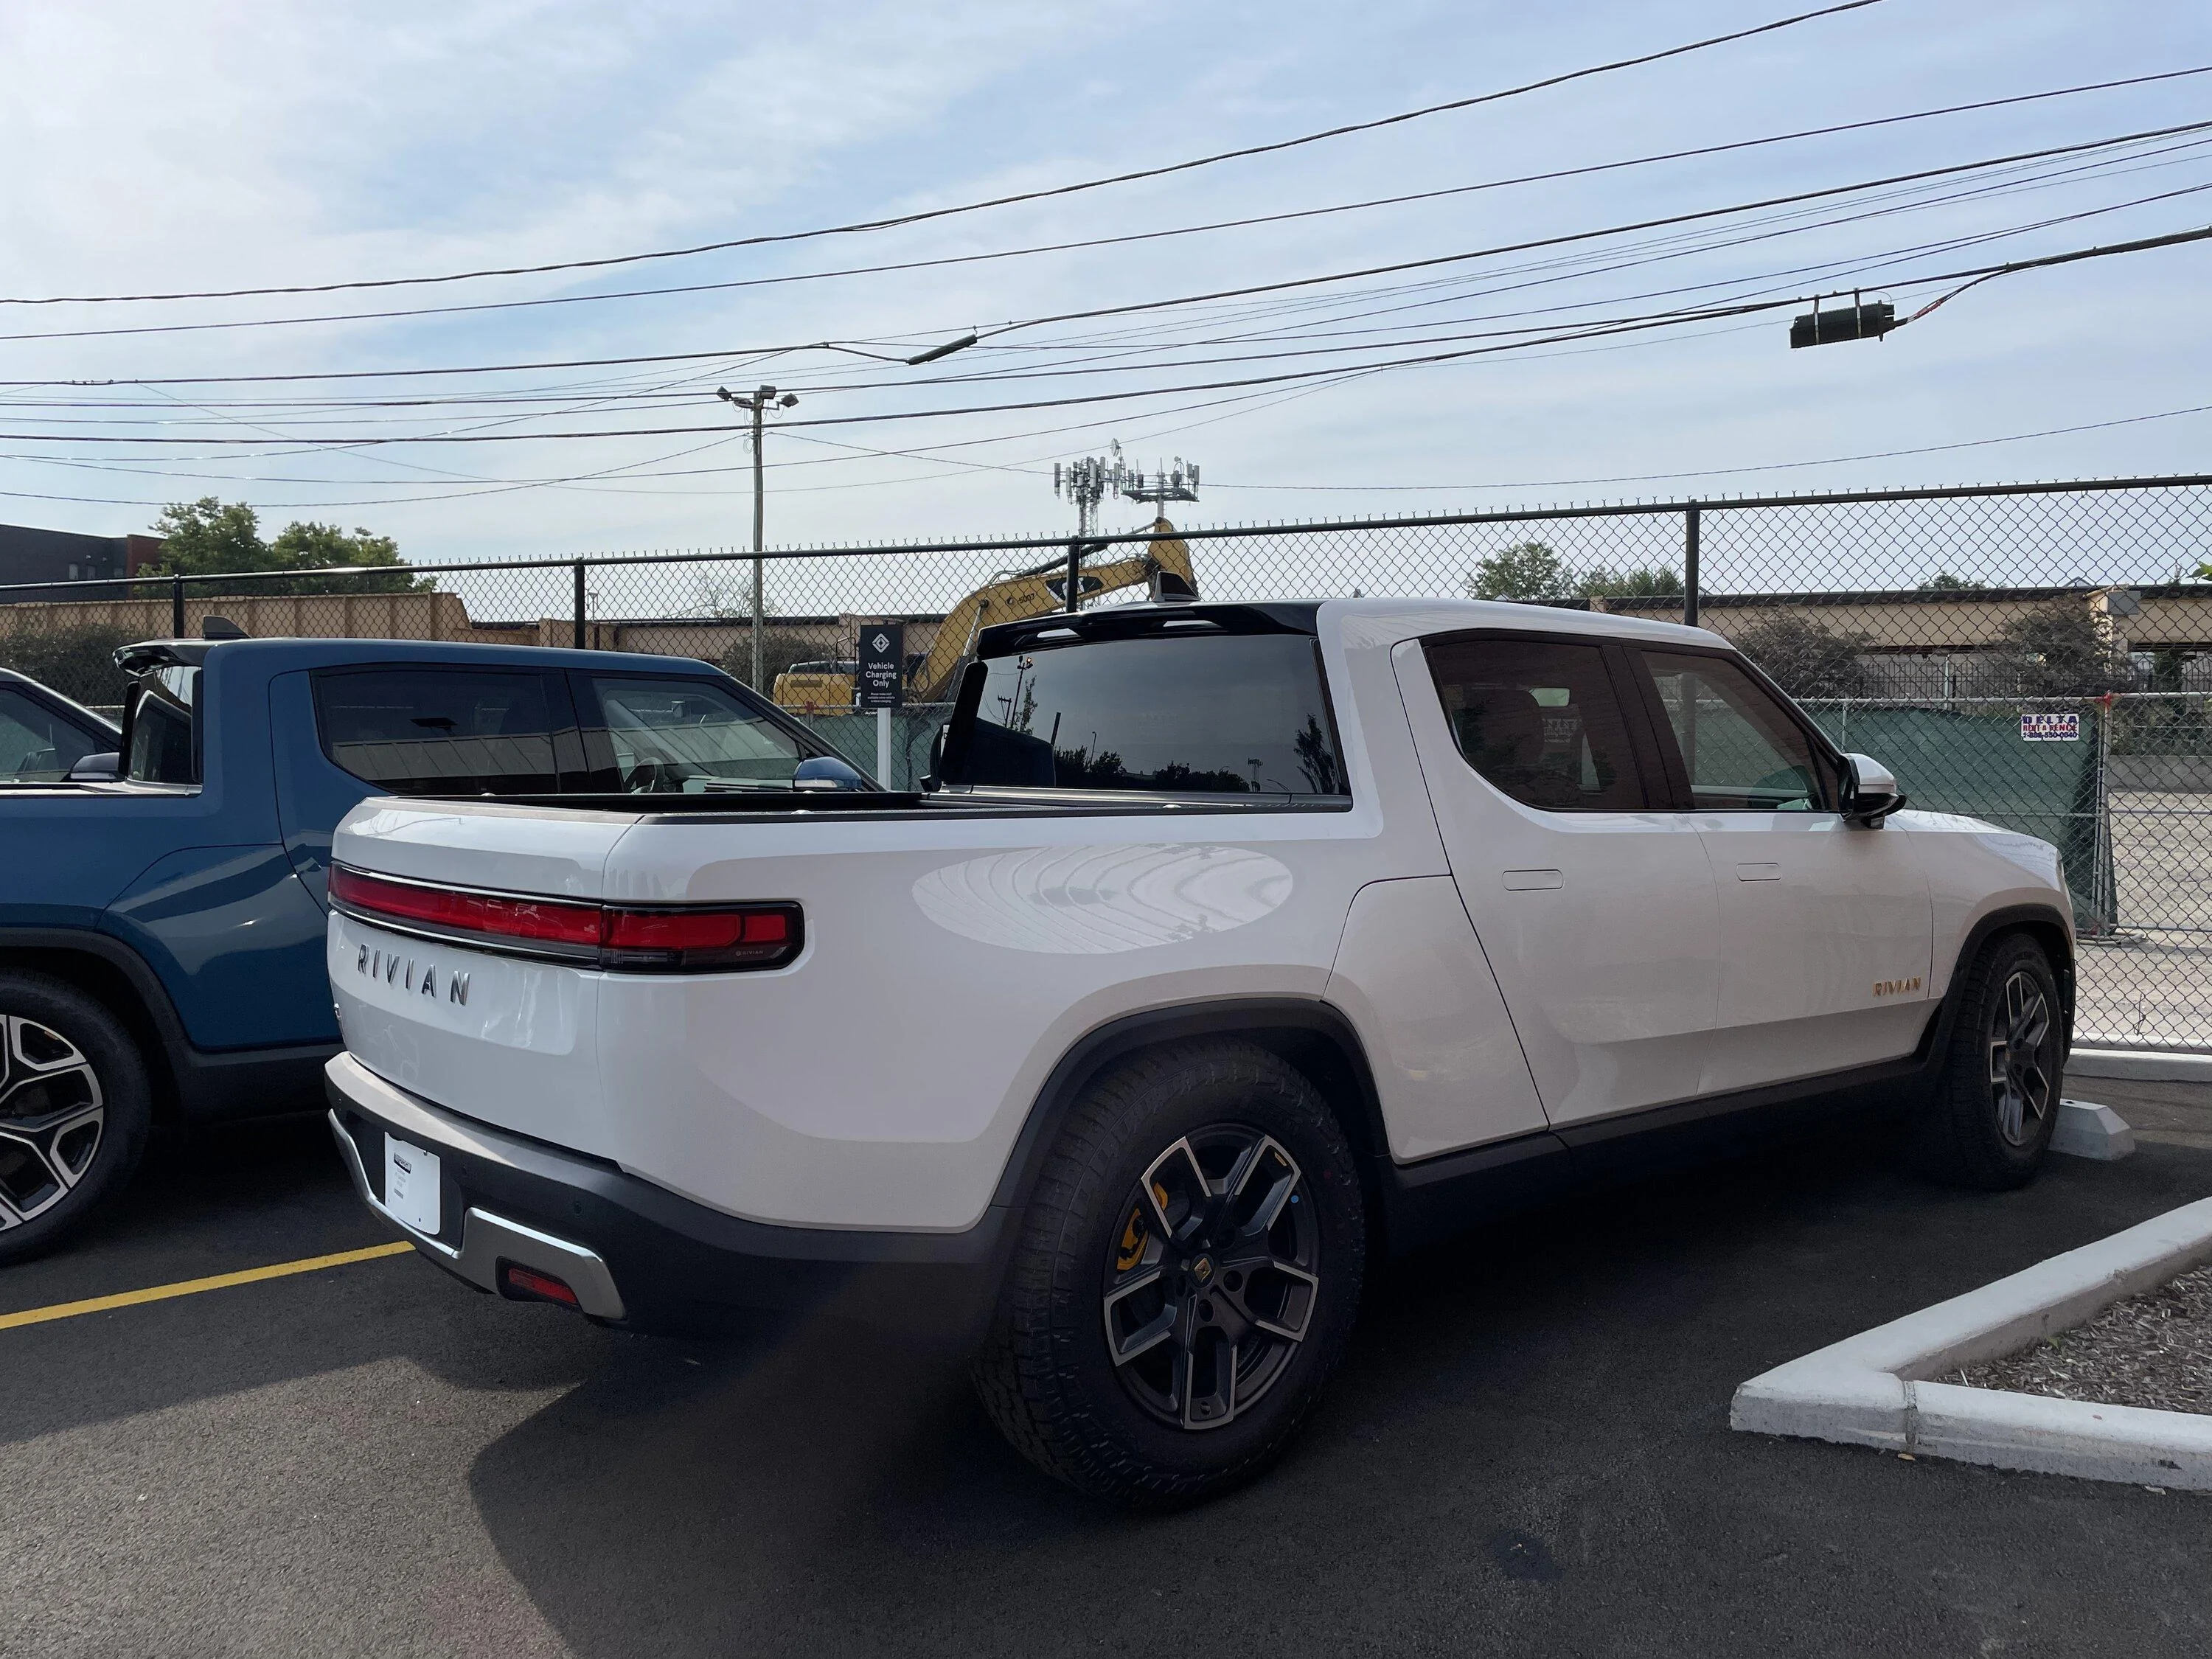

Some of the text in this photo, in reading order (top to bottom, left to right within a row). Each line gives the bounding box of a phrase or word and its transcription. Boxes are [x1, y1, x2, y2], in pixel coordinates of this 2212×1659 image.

[865, 671, 897, 679] Charging
[872, 679, 889, 688] Only
[2023, 716, 2078, 724] DELTA
[358, 943, 470, 1006] RIVIAN
[1873, 975, 1922, 998] RIVIAN
